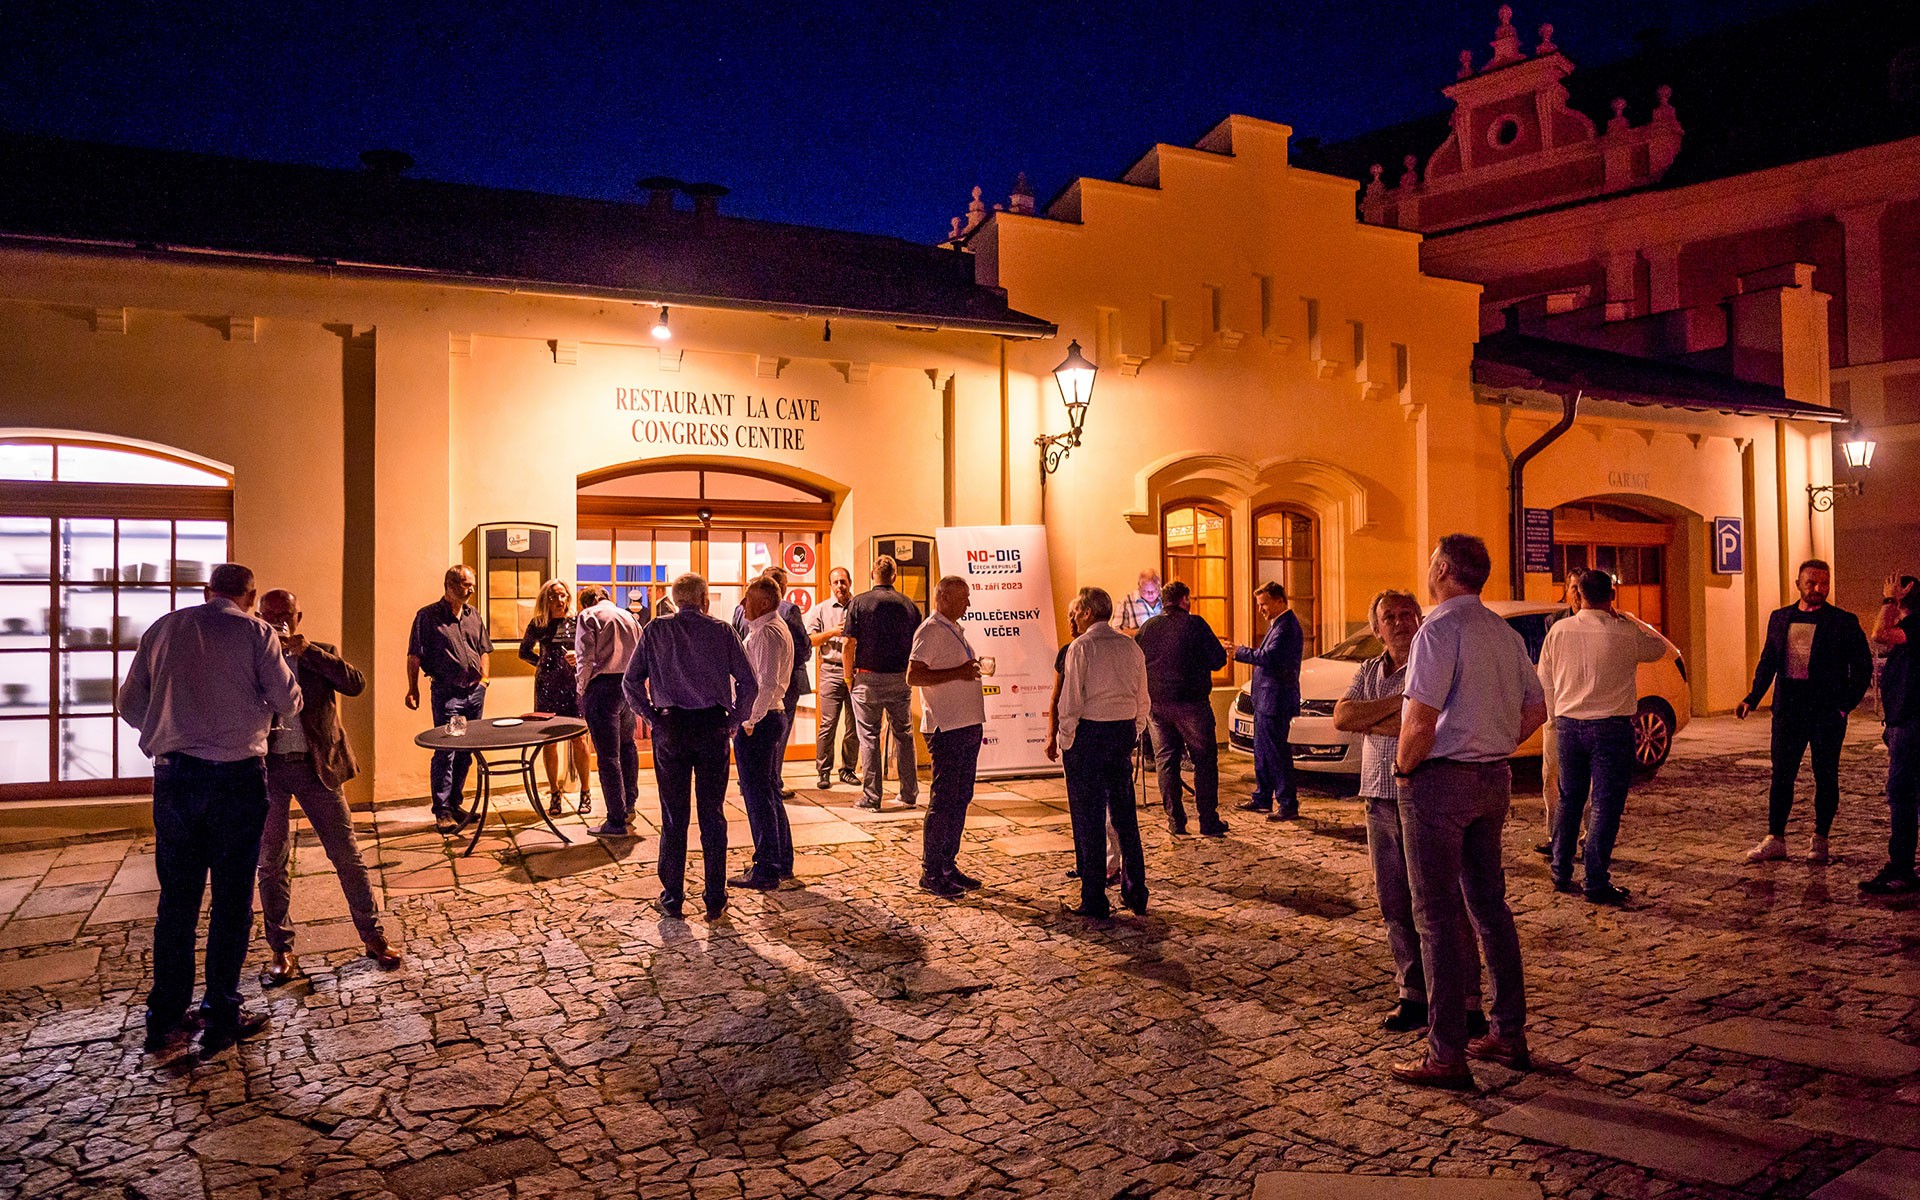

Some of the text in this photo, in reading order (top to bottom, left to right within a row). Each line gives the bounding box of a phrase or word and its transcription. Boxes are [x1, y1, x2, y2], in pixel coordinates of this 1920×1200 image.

[616, 387, 820, 422] RESTAURANT LA CAVE
[631, 419, 805, 451] CONGRESS CENTRE
[1608, 471, 1650, 489] GARAGE
[967, 549, 1021, 562] NO-DIG
[1722, 532, 1737, 565] P
[1001, 582, 1023, 590] 2023
[984, 625, 1020, 637] VEČER
